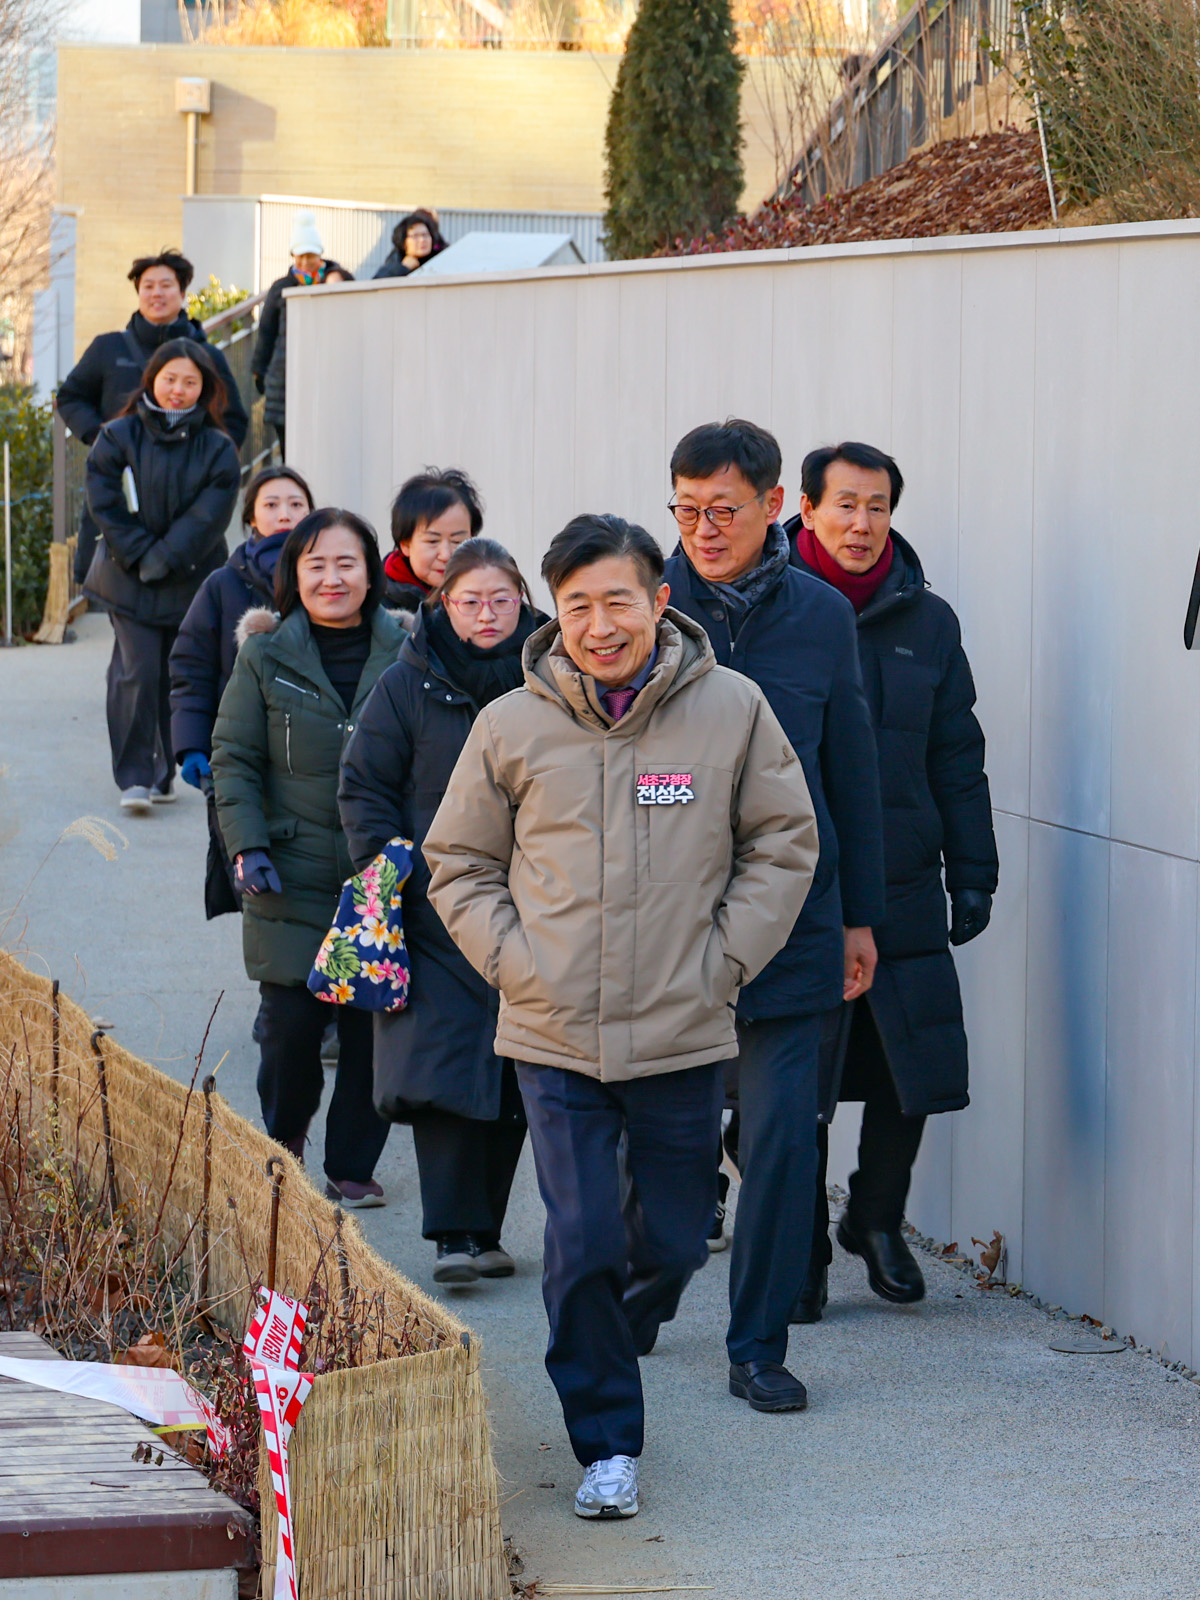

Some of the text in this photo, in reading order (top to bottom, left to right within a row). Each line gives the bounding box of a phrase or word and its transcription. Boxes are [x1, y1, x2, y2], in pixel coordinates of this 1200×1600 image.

[637, 773, 692, 786] 서초구청장
[636, 785, 695, 805] 전성수
[261, 1314, 288, 1363] DANGER
